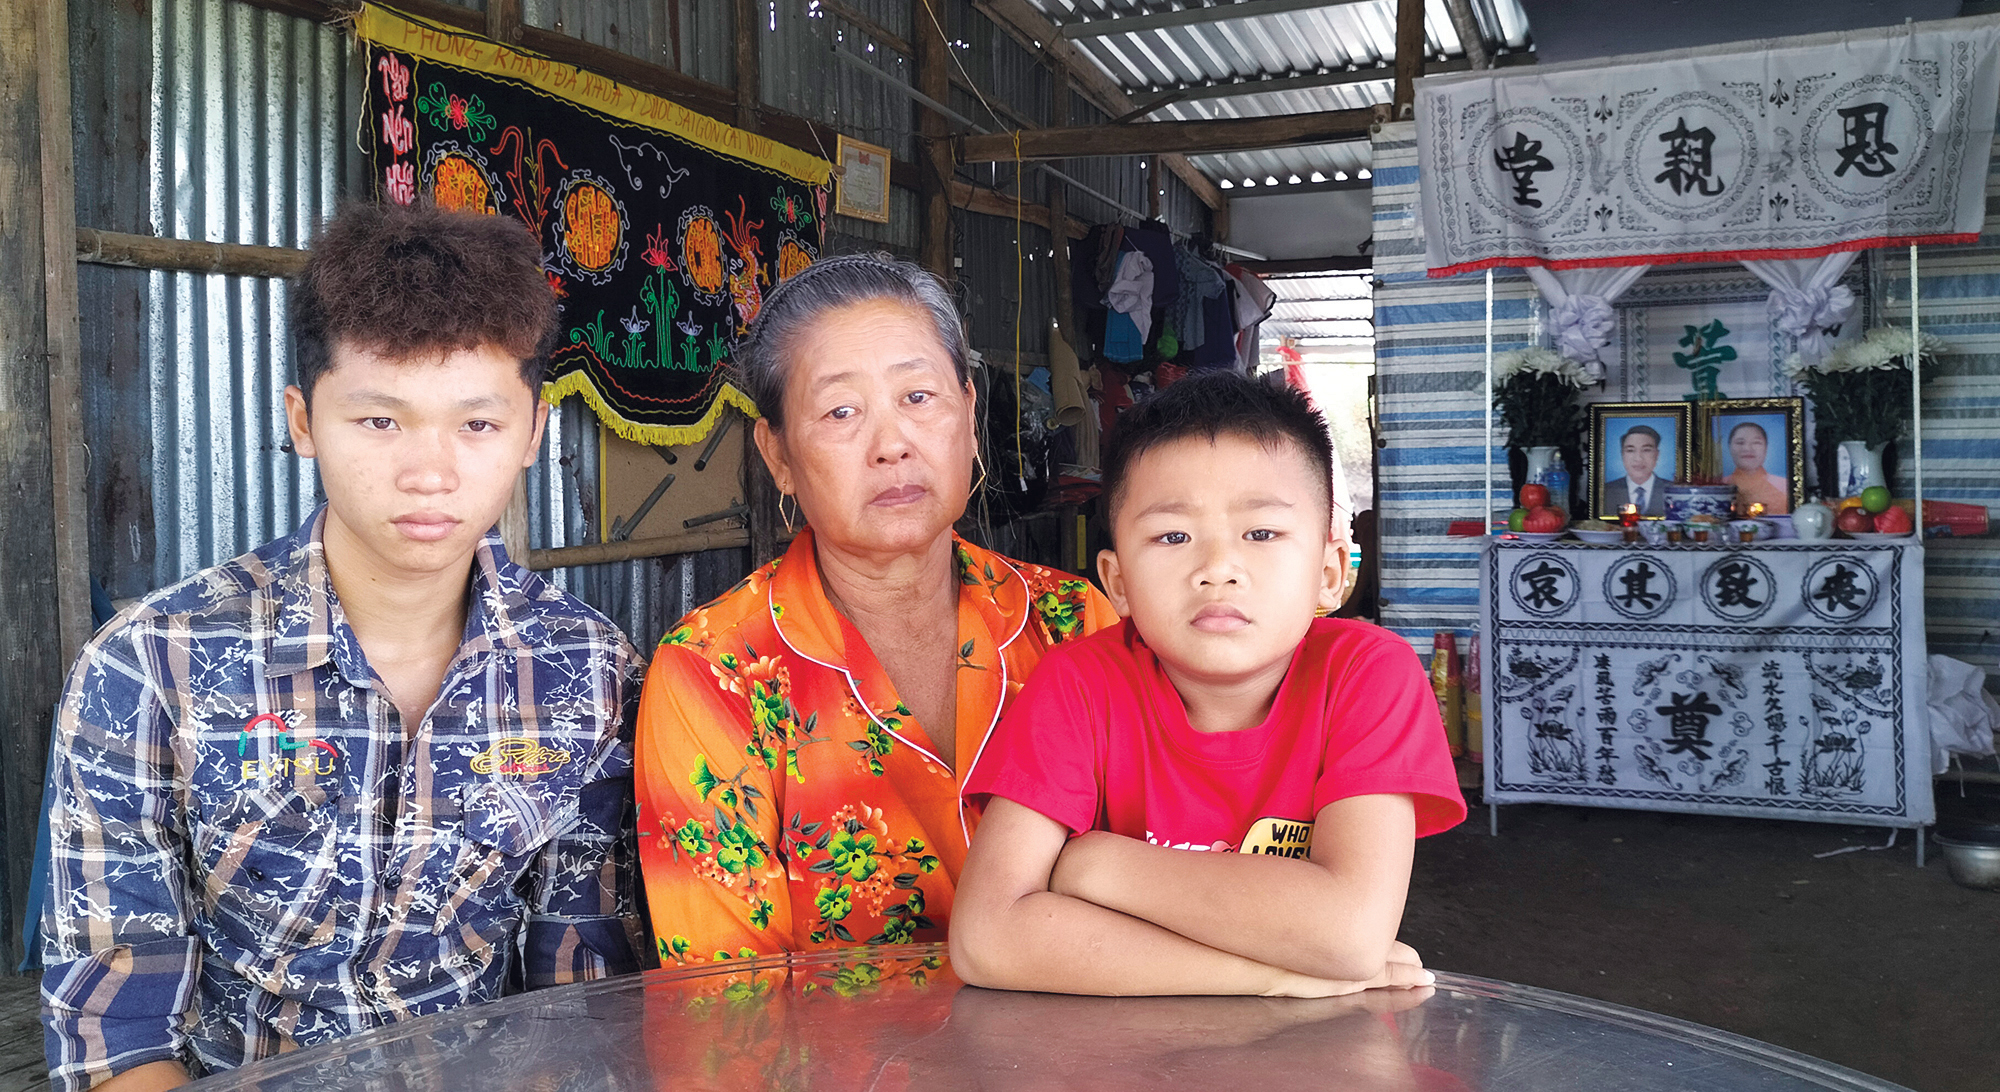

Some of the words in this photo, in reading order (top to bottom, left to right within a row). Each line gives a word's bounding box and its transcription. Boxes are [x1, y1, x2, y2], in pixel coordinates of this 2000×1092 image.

[1654, 691, 1724, 761] 奠
[242, 757, 335, 780] EVISU
[1271, 823, 1310, 845] WHO
